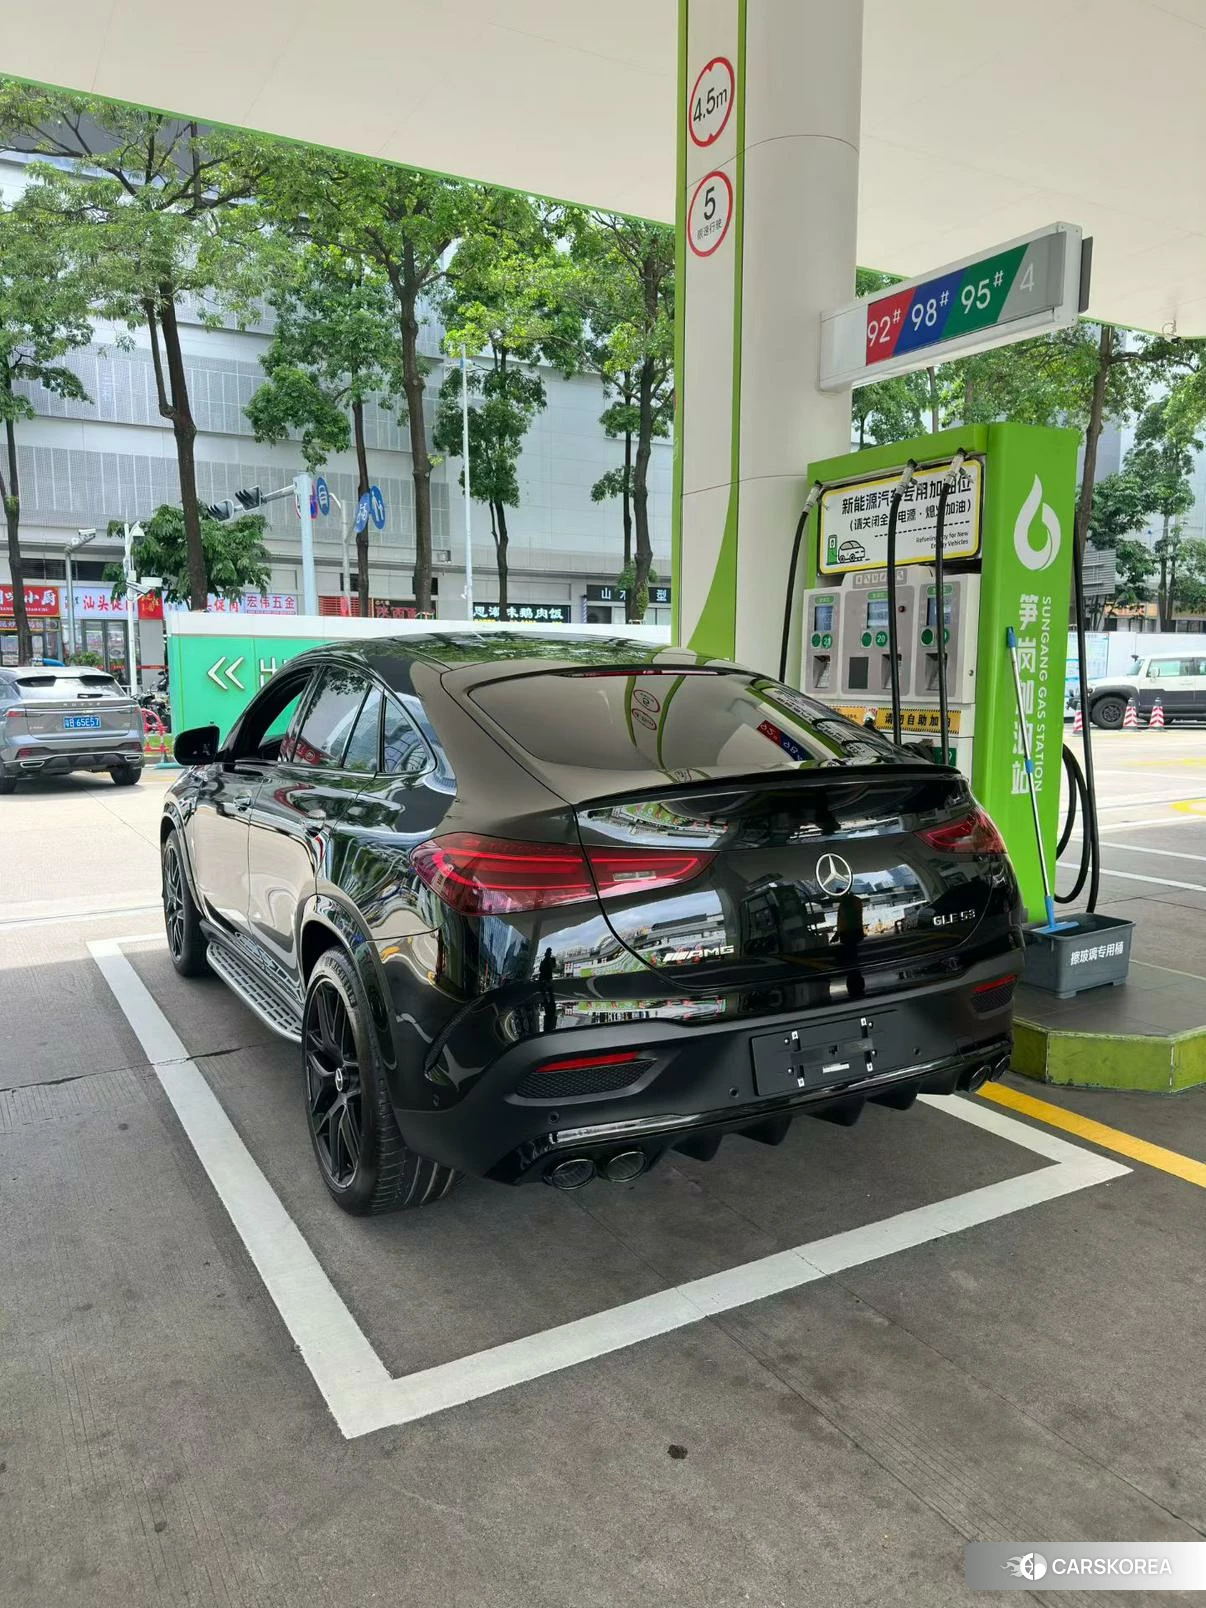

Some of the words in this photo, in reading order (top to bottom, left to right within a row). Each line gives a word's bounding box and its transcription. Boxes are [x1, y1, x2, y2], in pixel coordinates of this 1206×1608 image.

[693, 87, 728, 122] 4.5m
[703, 186, 717, 220] 5
[697, 218, 722, 240] 限速行驶
[867, 307, 901, 347] 92#
[911, 289, 949, 332] 98#
[961, 269, 1004, 315] 95#
[1019, 263, 1035, 293] 4
[247, 595, 295, 609] 宏伟五金
[876, 634, 886, 643] 20
[1039, 596, 1052, 682] SUNGANG
[1037, 687, 1047, 720] GAS
[1034, 723, 1046, 792] STATION
[687, 945, 735, 959] AMG
